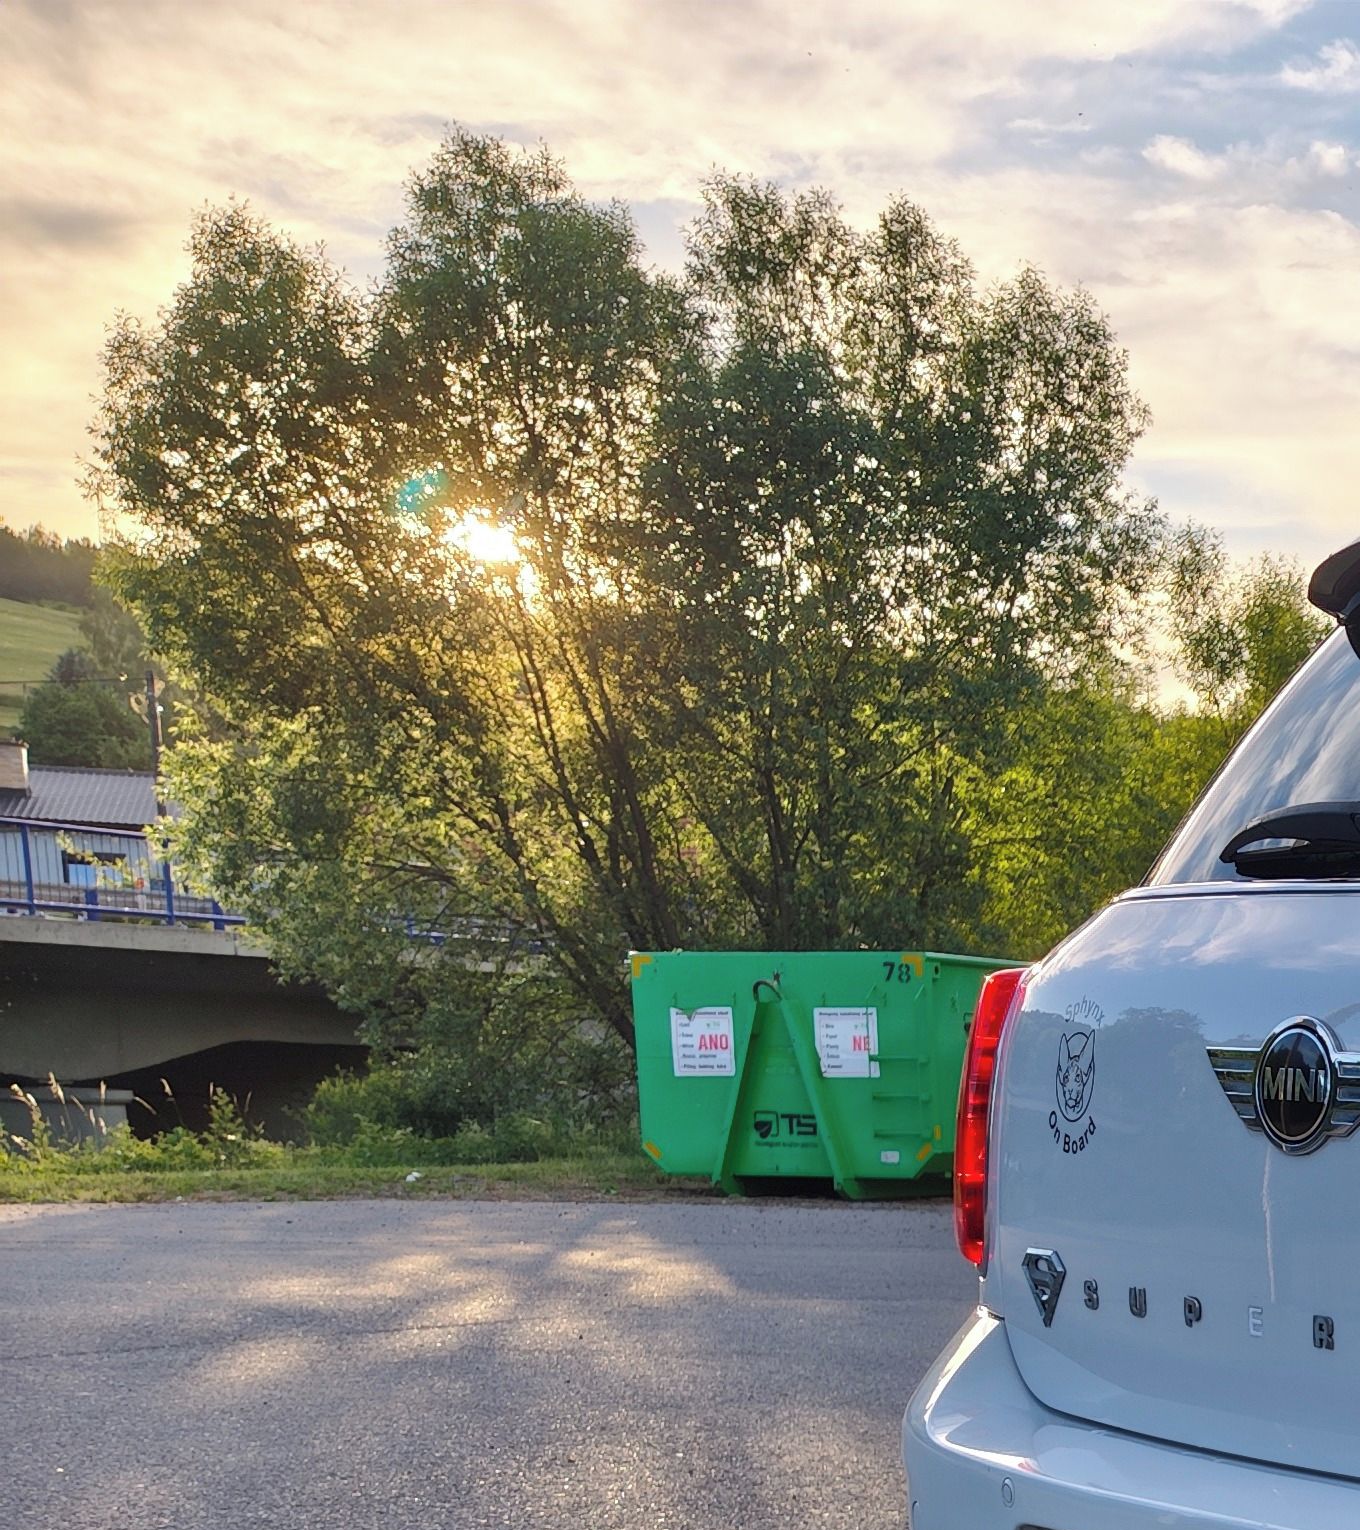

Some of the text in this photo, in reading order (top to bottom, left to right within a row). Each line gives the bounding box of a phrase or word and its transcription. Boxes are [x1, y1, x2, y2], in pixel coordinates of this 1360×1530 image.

[883, 961, 911, 984] 78
[1065, 994, 1105, 1030] Sphynx
[698, 1034, 729, 1051] ANO
[1263, 1066, 1326, 1103] MINI
[1049, 1110, 1097, 1155] On Board
